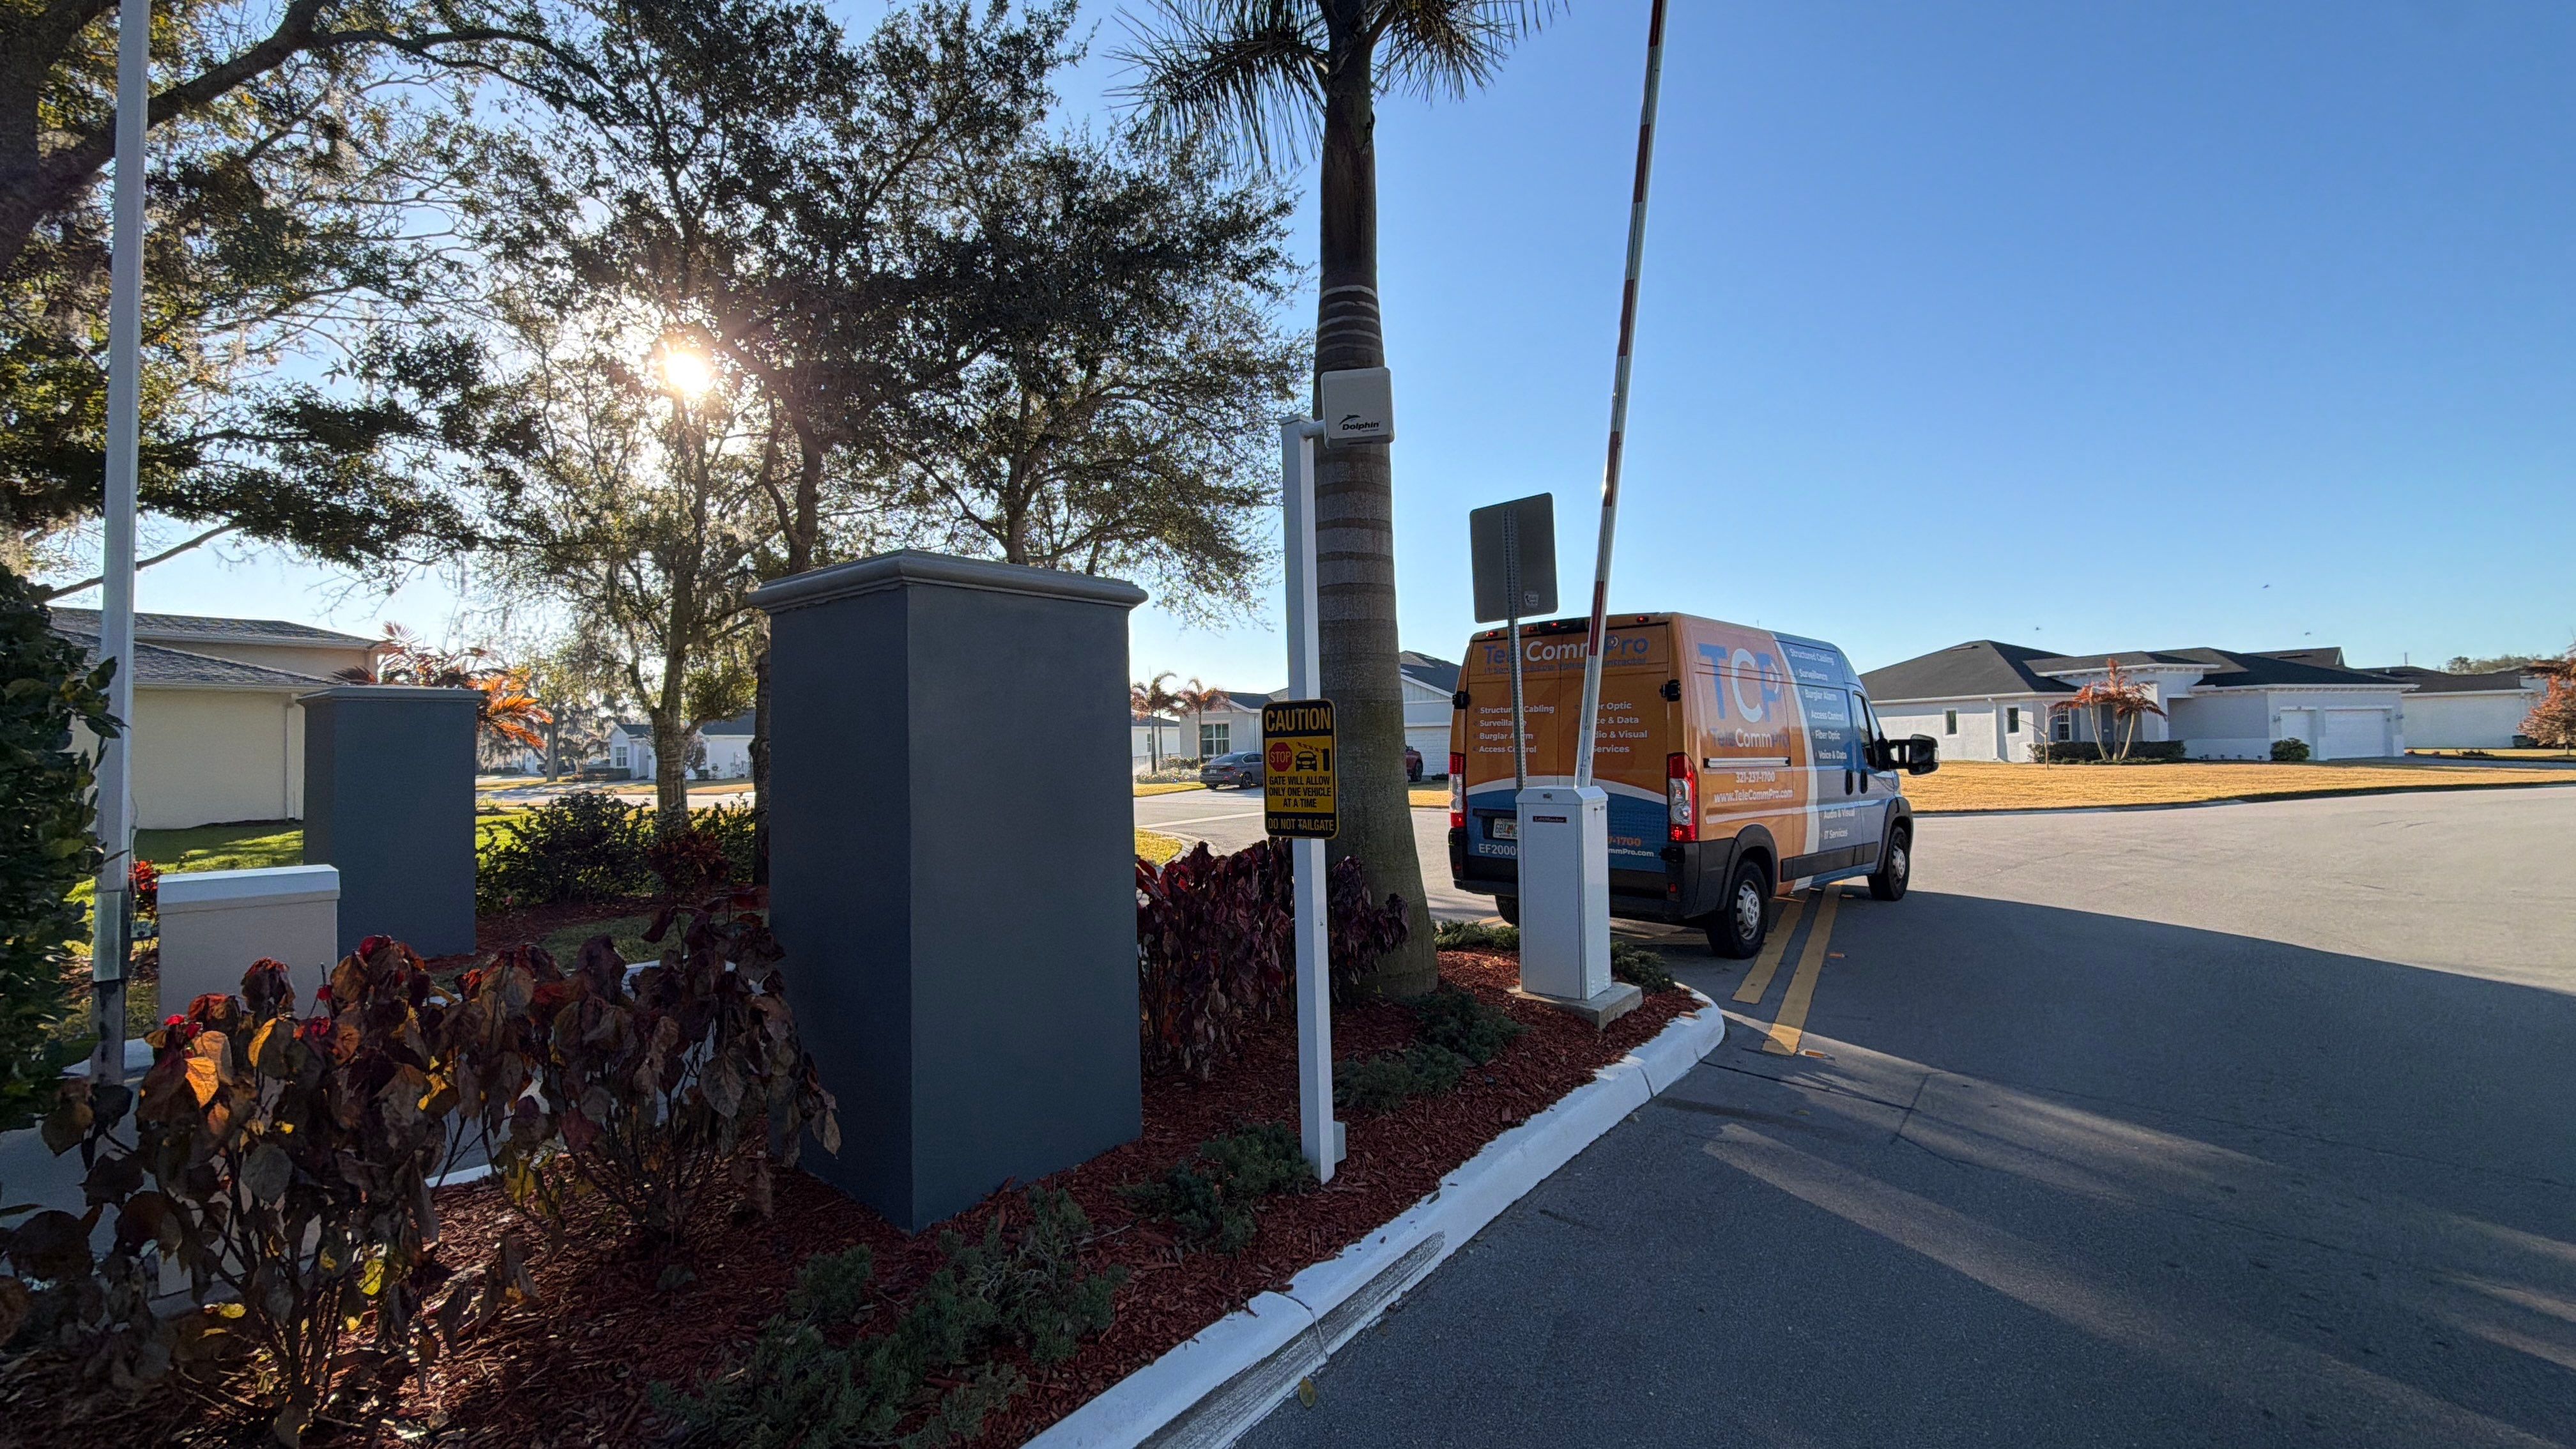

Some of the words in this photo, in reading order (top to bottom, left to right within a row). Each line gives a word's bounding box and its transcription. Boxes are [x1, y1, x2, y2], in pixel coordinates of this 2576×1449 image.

[1342, 421, 1379, 431] Dolphin
[1698, 643, 1782, 723] TCP
[1524, 704, 1555, 714] Cabling
[1606, 701, 1632, 710] Optic
[1266, 707, 1331, 733] CAUTION
[1480, 719, 1527, 727] Surveillae
[1480, 732, 1508, 741] Burglar
[1595, 730, 1607, 738] dio
[1618, 730, 1648, 738] Visual
[1815, 730, 1827, 739] Fiber
[1828, 730, 1841, 741] Optic
[1593, 744, 1630, 753] Services
[1270, 751, 1291, 763] STOP
[1818, 749, 1832, 760] Voice
[1836, 750, 1848, 760] Data
[1269, 776, 1286, 786] GATE
[1287, 776, 1304, 785] WILL
[1306, 776, 1331, 785] ALLOW
[1735, 770, 1775, 783] 321-237-1700
[1269, 787, 1286, 797] ONLY
[1287, 787, 1302, 797] ONE
[1303, 786, 1331, 797] VEHICLE
[1713, 788, 1793, 804] www.TeleCommPro.com
[1283, 799, 1293, 808] AT
[1293, 799, 1299, 808] A
[1300, 799, 1317, 808] TIME
[1268, 818, 1278, 829] DO
[1280, 818, 1296, 830] NOT
[1298, 818, 1334, 831] TAILGATE
[1478, 843, 1518, 855] EF2000
[1608, 848, 1654, 857] mmPro.com
